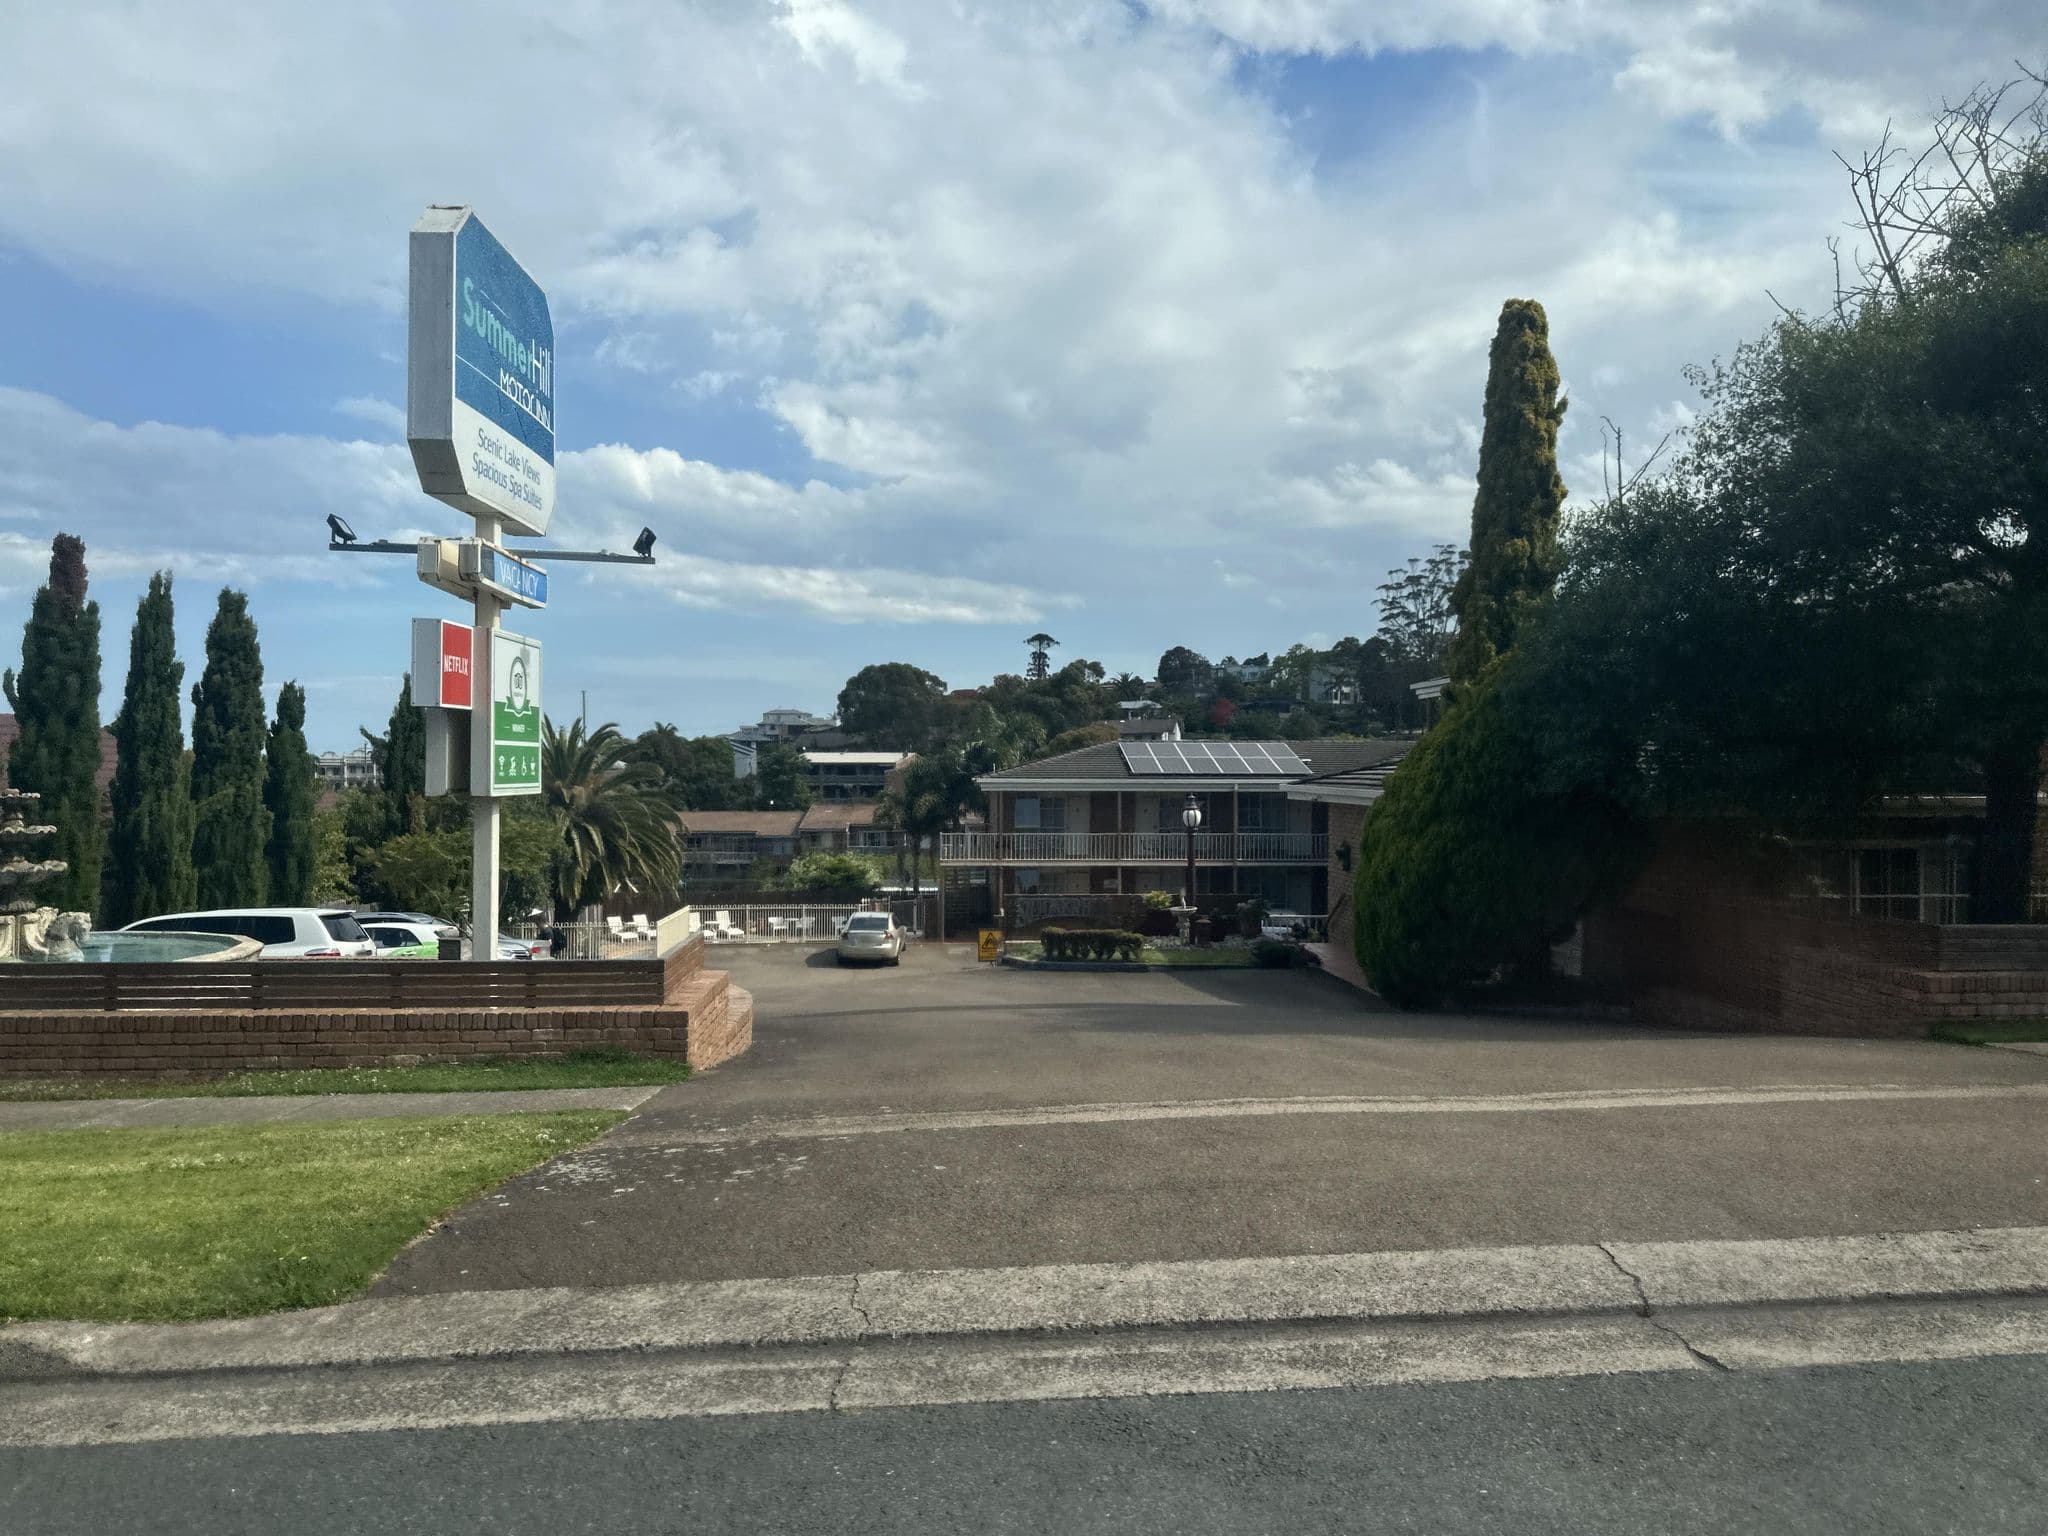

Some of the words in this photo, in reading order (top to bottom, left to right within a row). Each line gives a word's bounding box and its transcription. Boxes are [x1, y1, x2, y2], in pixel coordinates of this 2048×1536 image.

[477, 427, 503, 461] Scenic
[504, 443, 521, 472] Lake
[522, 456, 541, 486] Views
[472, 452, 508, 490] Spacious
[508, 474, 522, 500] Spa
[523, 483, 543, 511] Suites
[500, 561, 539, 597] VACANCY
[443, 653, 469, 677] NETFLIX
